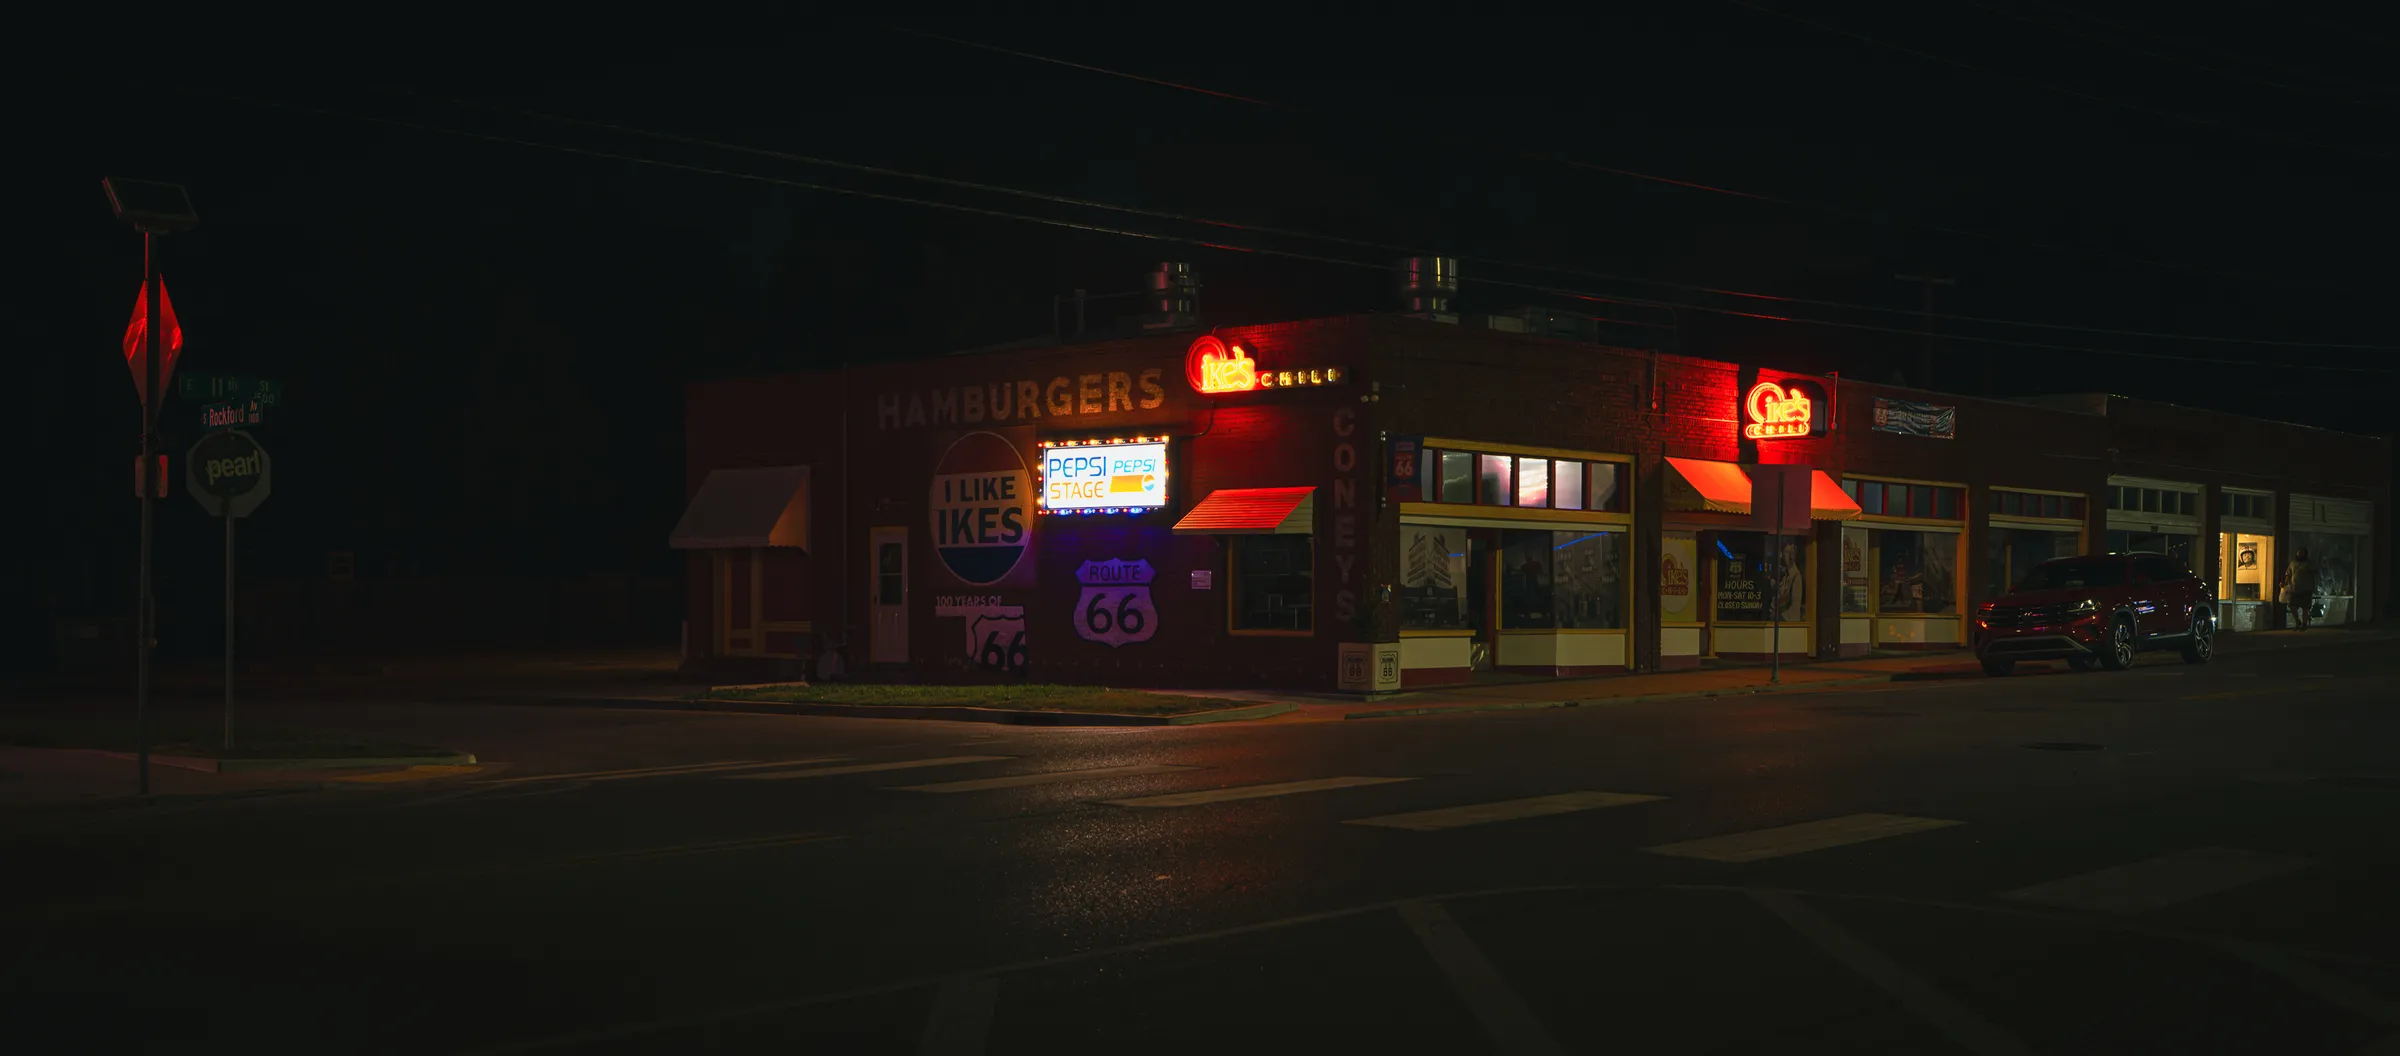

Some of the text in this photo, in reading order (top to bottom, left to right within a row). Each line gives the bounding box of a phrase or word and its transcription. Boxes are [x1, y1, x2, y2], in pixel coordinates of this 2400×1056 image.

[1260, 368, 1336, 388] CHILI
[877, 368, 1166, 430] HAMBURGERS
[208, 402, 245, 428] Rockford
[206, 449, 261, 486] pearl
[1049, 456, 1157, 478] PEPSI PEPSI
[1395, 460, 1414, 476] 66
[944, 476, 1017, 502] I LIKE
[1049, 480, 1105, 499] STAGE
[938, 506, 1024, 545] IKES
[1332, 406, 1357, 623] CONEYS
[1089, 564, 1141, 581] ROUTE
[1724, 580, 1754, 590] HOURS
[936, 595, 1002, 606] 100 YEARS OF
[1086, 593, 1144, 634] 66
[982, 631, 1028, 671] 66
